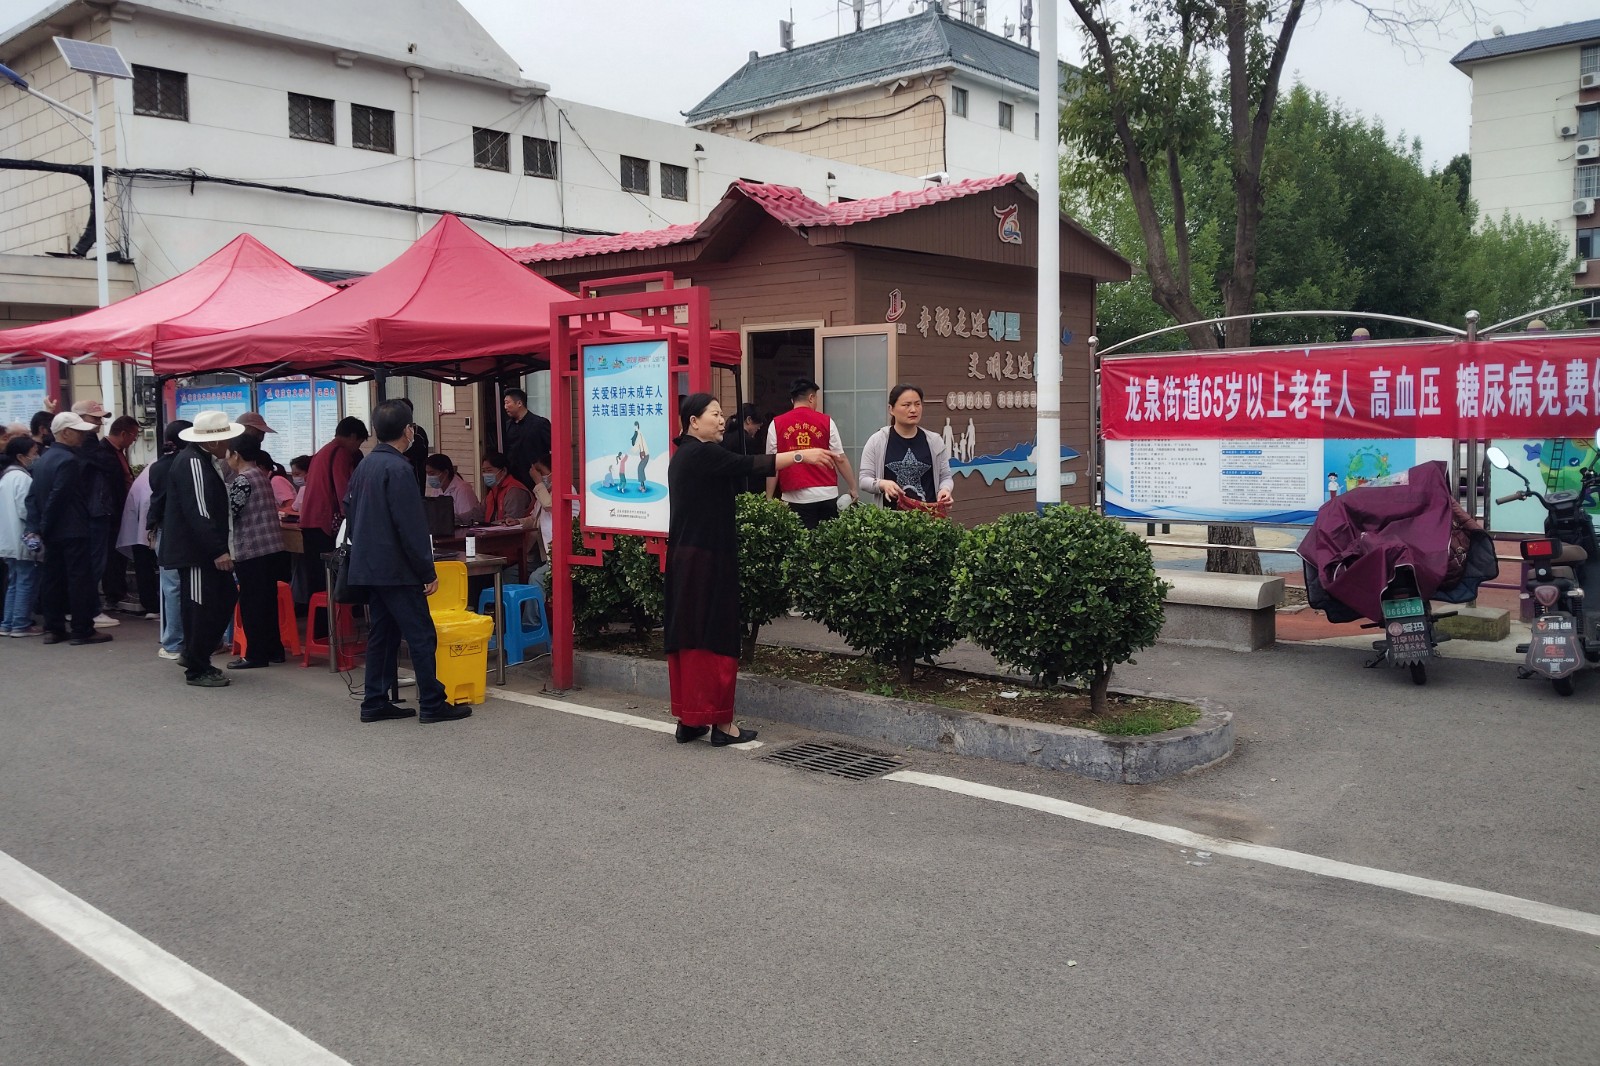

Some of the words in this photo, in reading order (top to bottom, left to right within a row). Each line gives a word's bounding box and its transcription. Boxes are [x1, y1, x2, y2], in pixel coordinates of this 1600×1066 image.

[916, 305, 1021, 342] 幸福走进邻里
[967, 351, 1063, 382] 文明走进
[591, 385, 663, 401] 关爱保护未成年人
[947, 391, 992, 409] 文明的小区
[1124, 367, 1356, 422] 龙泉街道65岁以上老年人
[1369, 364, 1442, 420] 高血压
[591, 403, 664, 417] 共筑祖国美好未来
